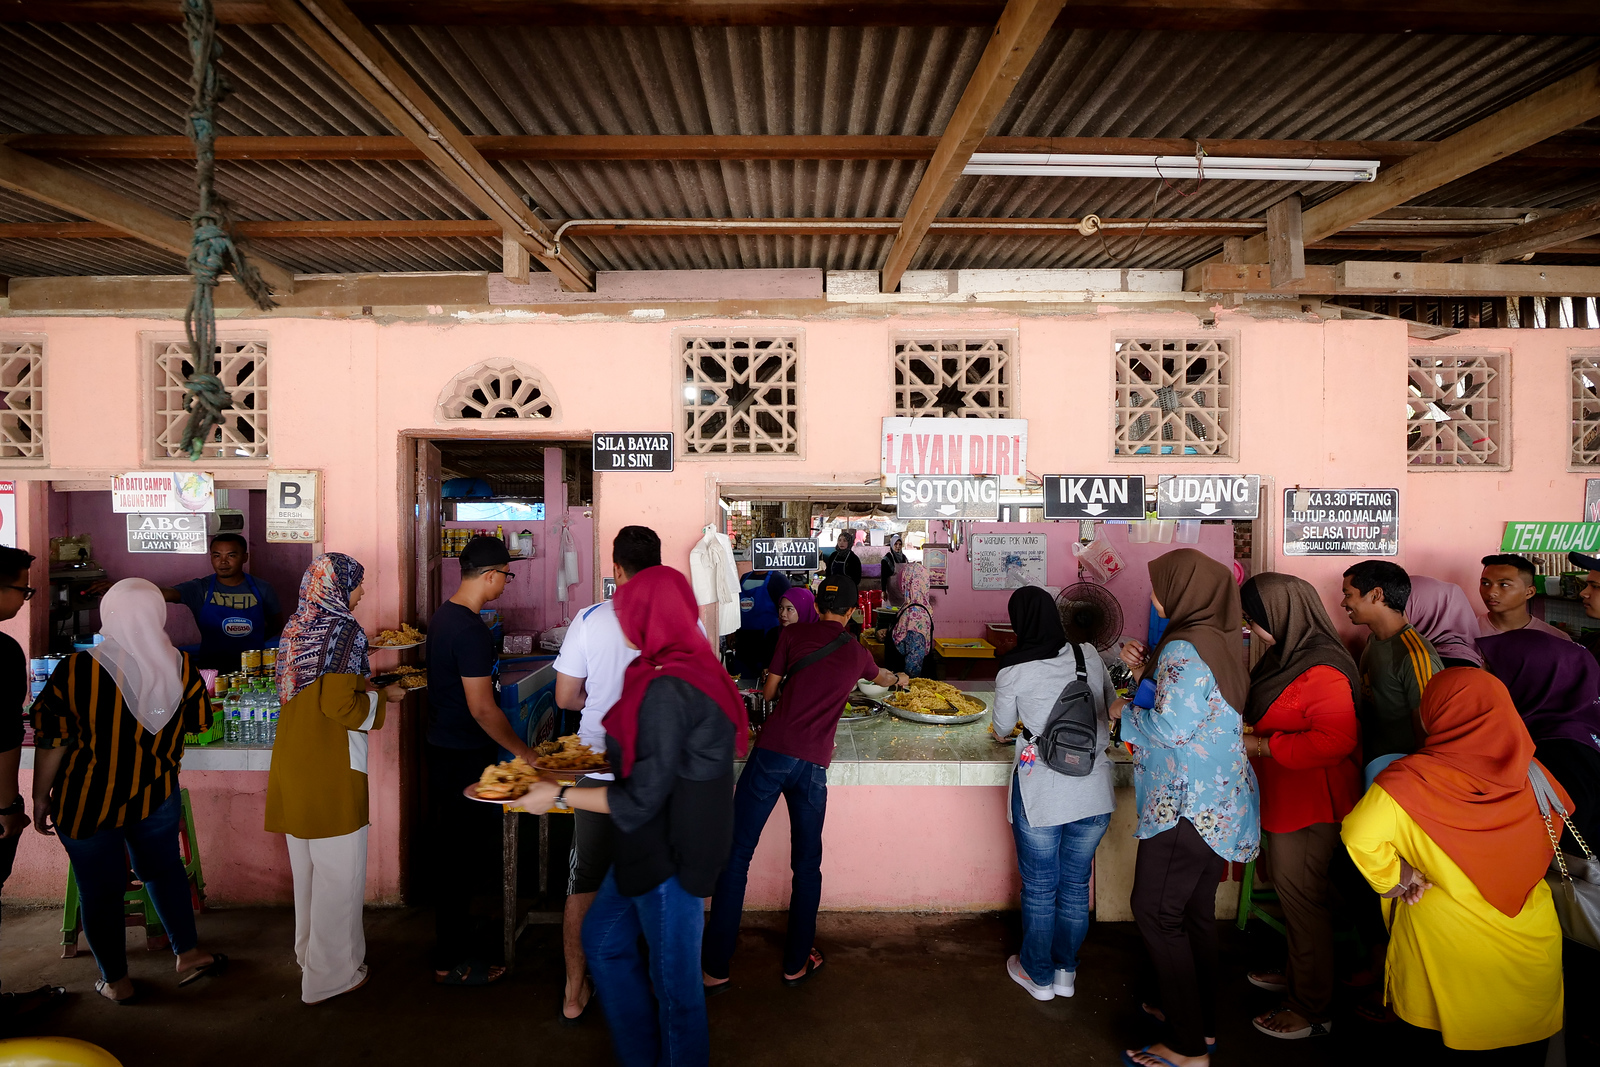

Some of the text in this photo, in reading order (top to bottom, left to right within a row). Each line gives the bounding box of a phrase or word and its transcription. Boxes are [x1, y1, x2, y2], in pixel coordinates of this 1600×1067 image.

[597, 437, 669, 451] SILA BAYAR
[612, 453, 653, 468] DI SINI
[886, 433, 1020, 476] LAYAN DIRI
[114, 478, 172, 491] AIR BATU CAMPUR
[1059, 478, 1129, 504] IKAN
[1168, 478, 1249, 503] UDANG
[280, 482, 302, 508] B
[901, 479, 996, 504] SOTONG
[120, 494, 167, 507] JAGUNG PARUT
[1293, 493, 1392, 506] KA 3.30 PETANG
[1292, 510, 1392, 523] TUTUP 8.00 MALAM
[139, 517, 191, 531] ABC
[133, 531, 201, 540] JAGUNG PARUT
[1302, 526, 1380, 539] SELASA TUTUP
[1512, 524, 1600, 551] TEH HIJAU
[142, 541, 192, 550] LAYAN DIRI
[755, 542, 816, 554] SILA BAYAR
[1325, 541, 1340, 551] CUTI
[765, 555, 806, 567] DAHULU
